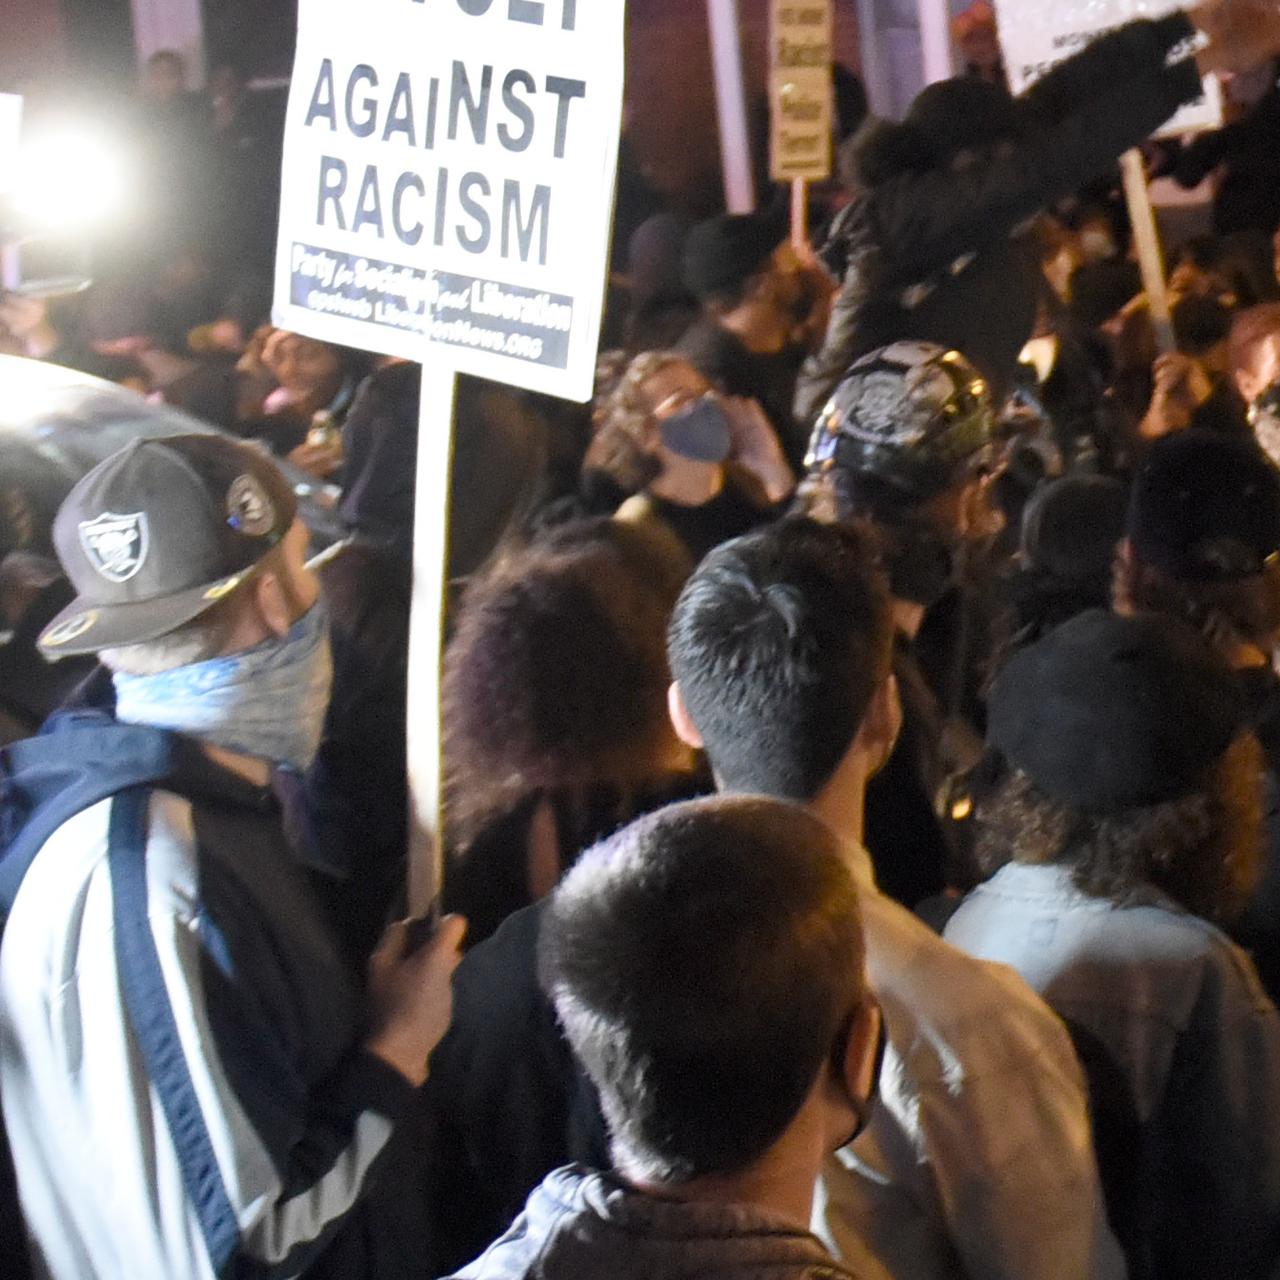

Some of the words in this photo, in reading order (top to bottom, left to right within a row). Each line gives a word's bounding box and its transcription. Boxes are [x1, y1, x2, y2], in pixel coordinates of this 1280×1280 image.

[304, 57, 588, 159] AGAINST
[315, 154, 553, 267] RACISM
[291, 243, 336, 287] Party
[470, 279, 573, 332] Liberation
